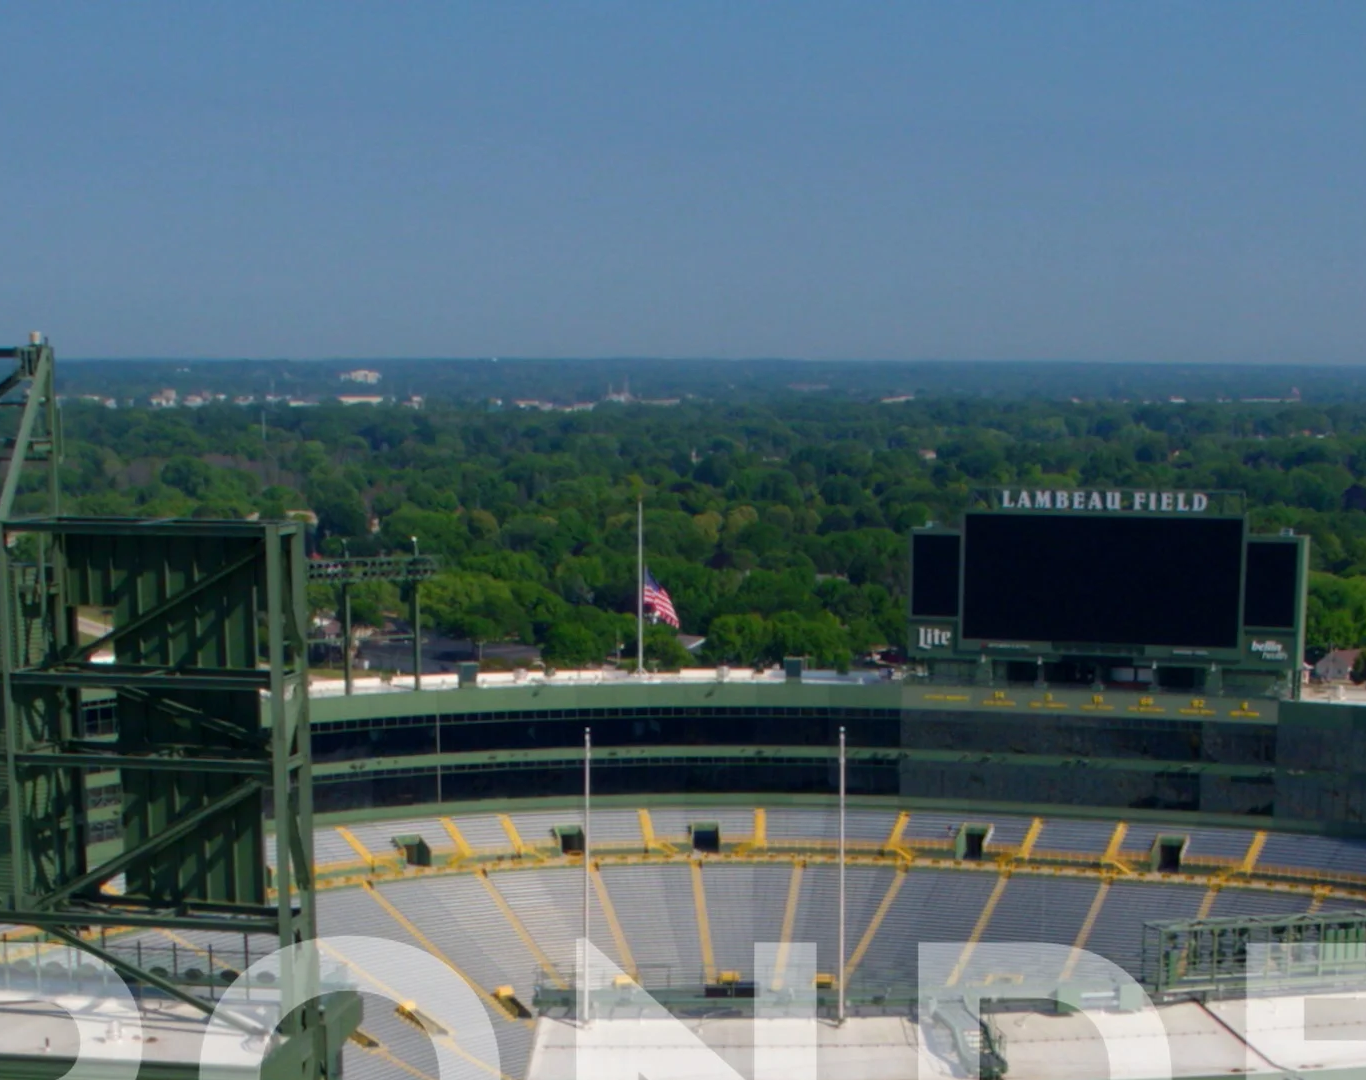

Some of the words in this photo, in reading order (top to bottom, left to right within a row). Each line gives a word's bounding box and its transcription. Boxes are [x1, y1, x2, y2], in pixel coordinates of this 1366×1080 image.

[1001, 489, 1121, 511] LAMBEAU
[1134, 491, 1209, 512] FIELD
[917, 626, 952, 650] Lite
